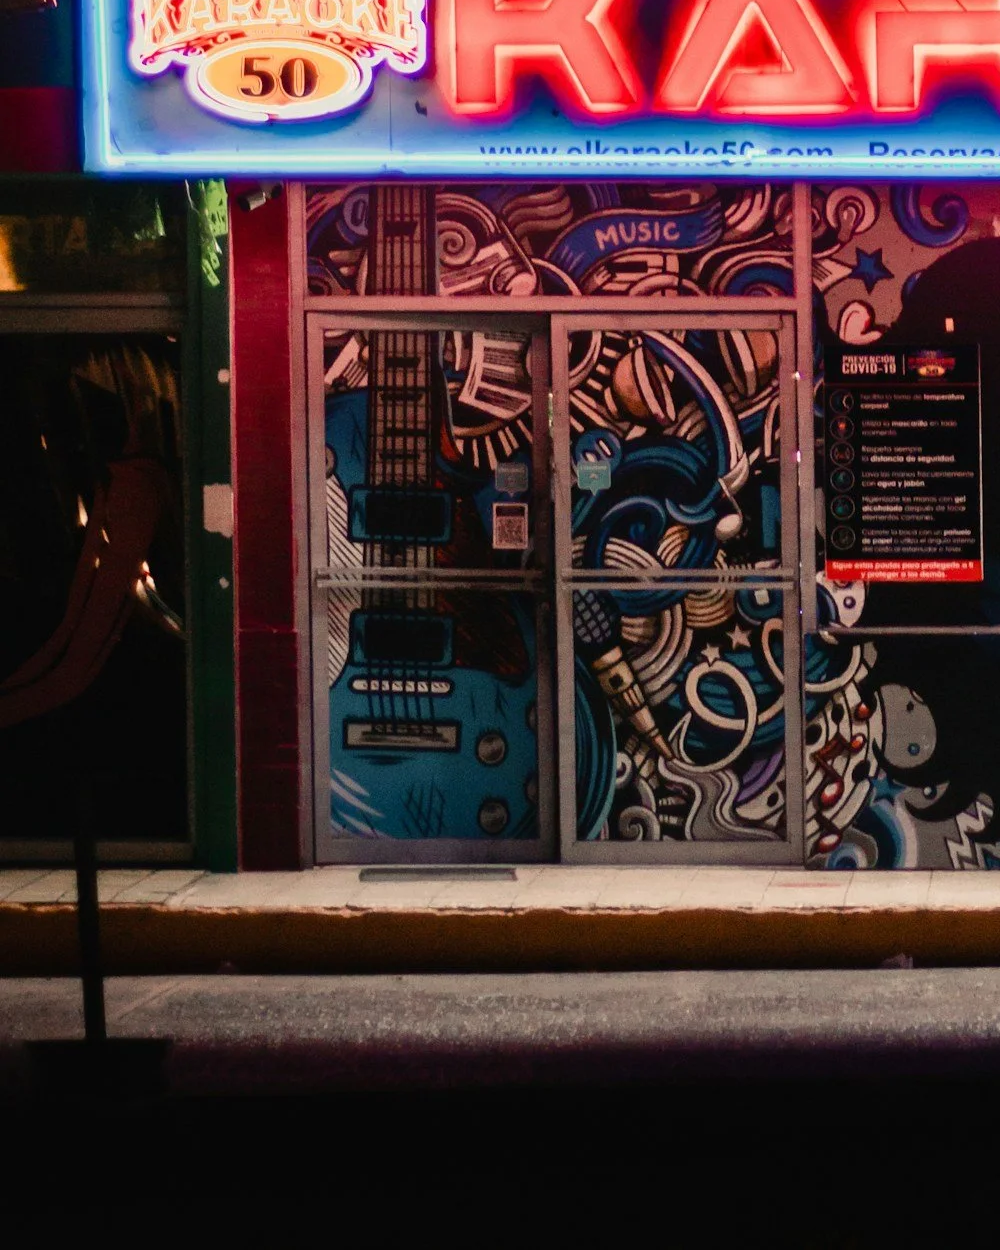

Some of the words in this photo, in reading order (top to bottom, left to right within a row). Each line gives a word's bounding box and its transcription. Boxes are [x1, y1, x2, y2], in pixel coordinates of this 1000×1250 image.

[238, 55, 321, 99] 50
[594, 221, 680, 251] MUSIC
[841, 363, 897, 375] COVID-19
[842, 354, 896, 363] PREVENCIÓN
